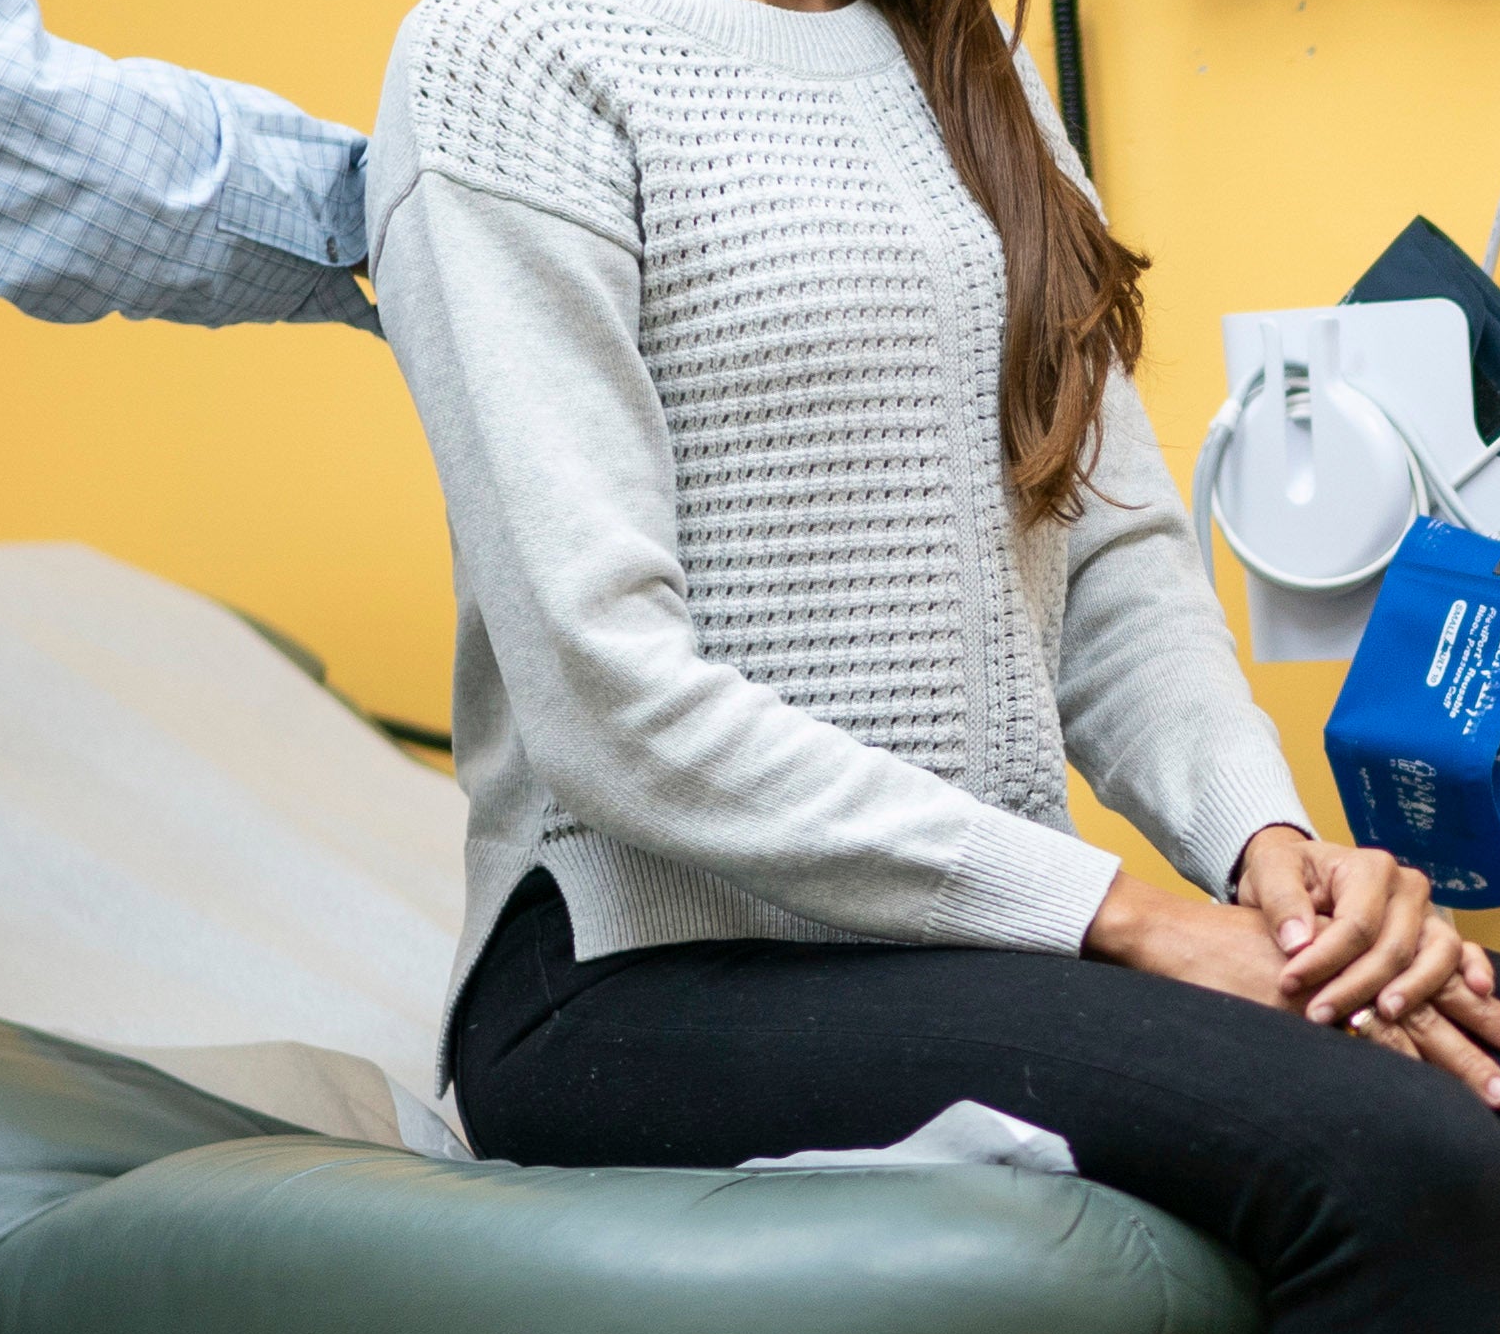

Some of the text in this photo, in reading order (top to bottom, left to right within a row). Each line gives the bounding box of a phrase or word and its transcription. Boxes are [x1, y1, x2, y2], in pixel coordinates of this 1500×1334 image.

[1443, 602, 1465, 639] SMALL
[1432, 637, 1453, 671] AULT
[1447, 666, 1476, 720] Reusable
